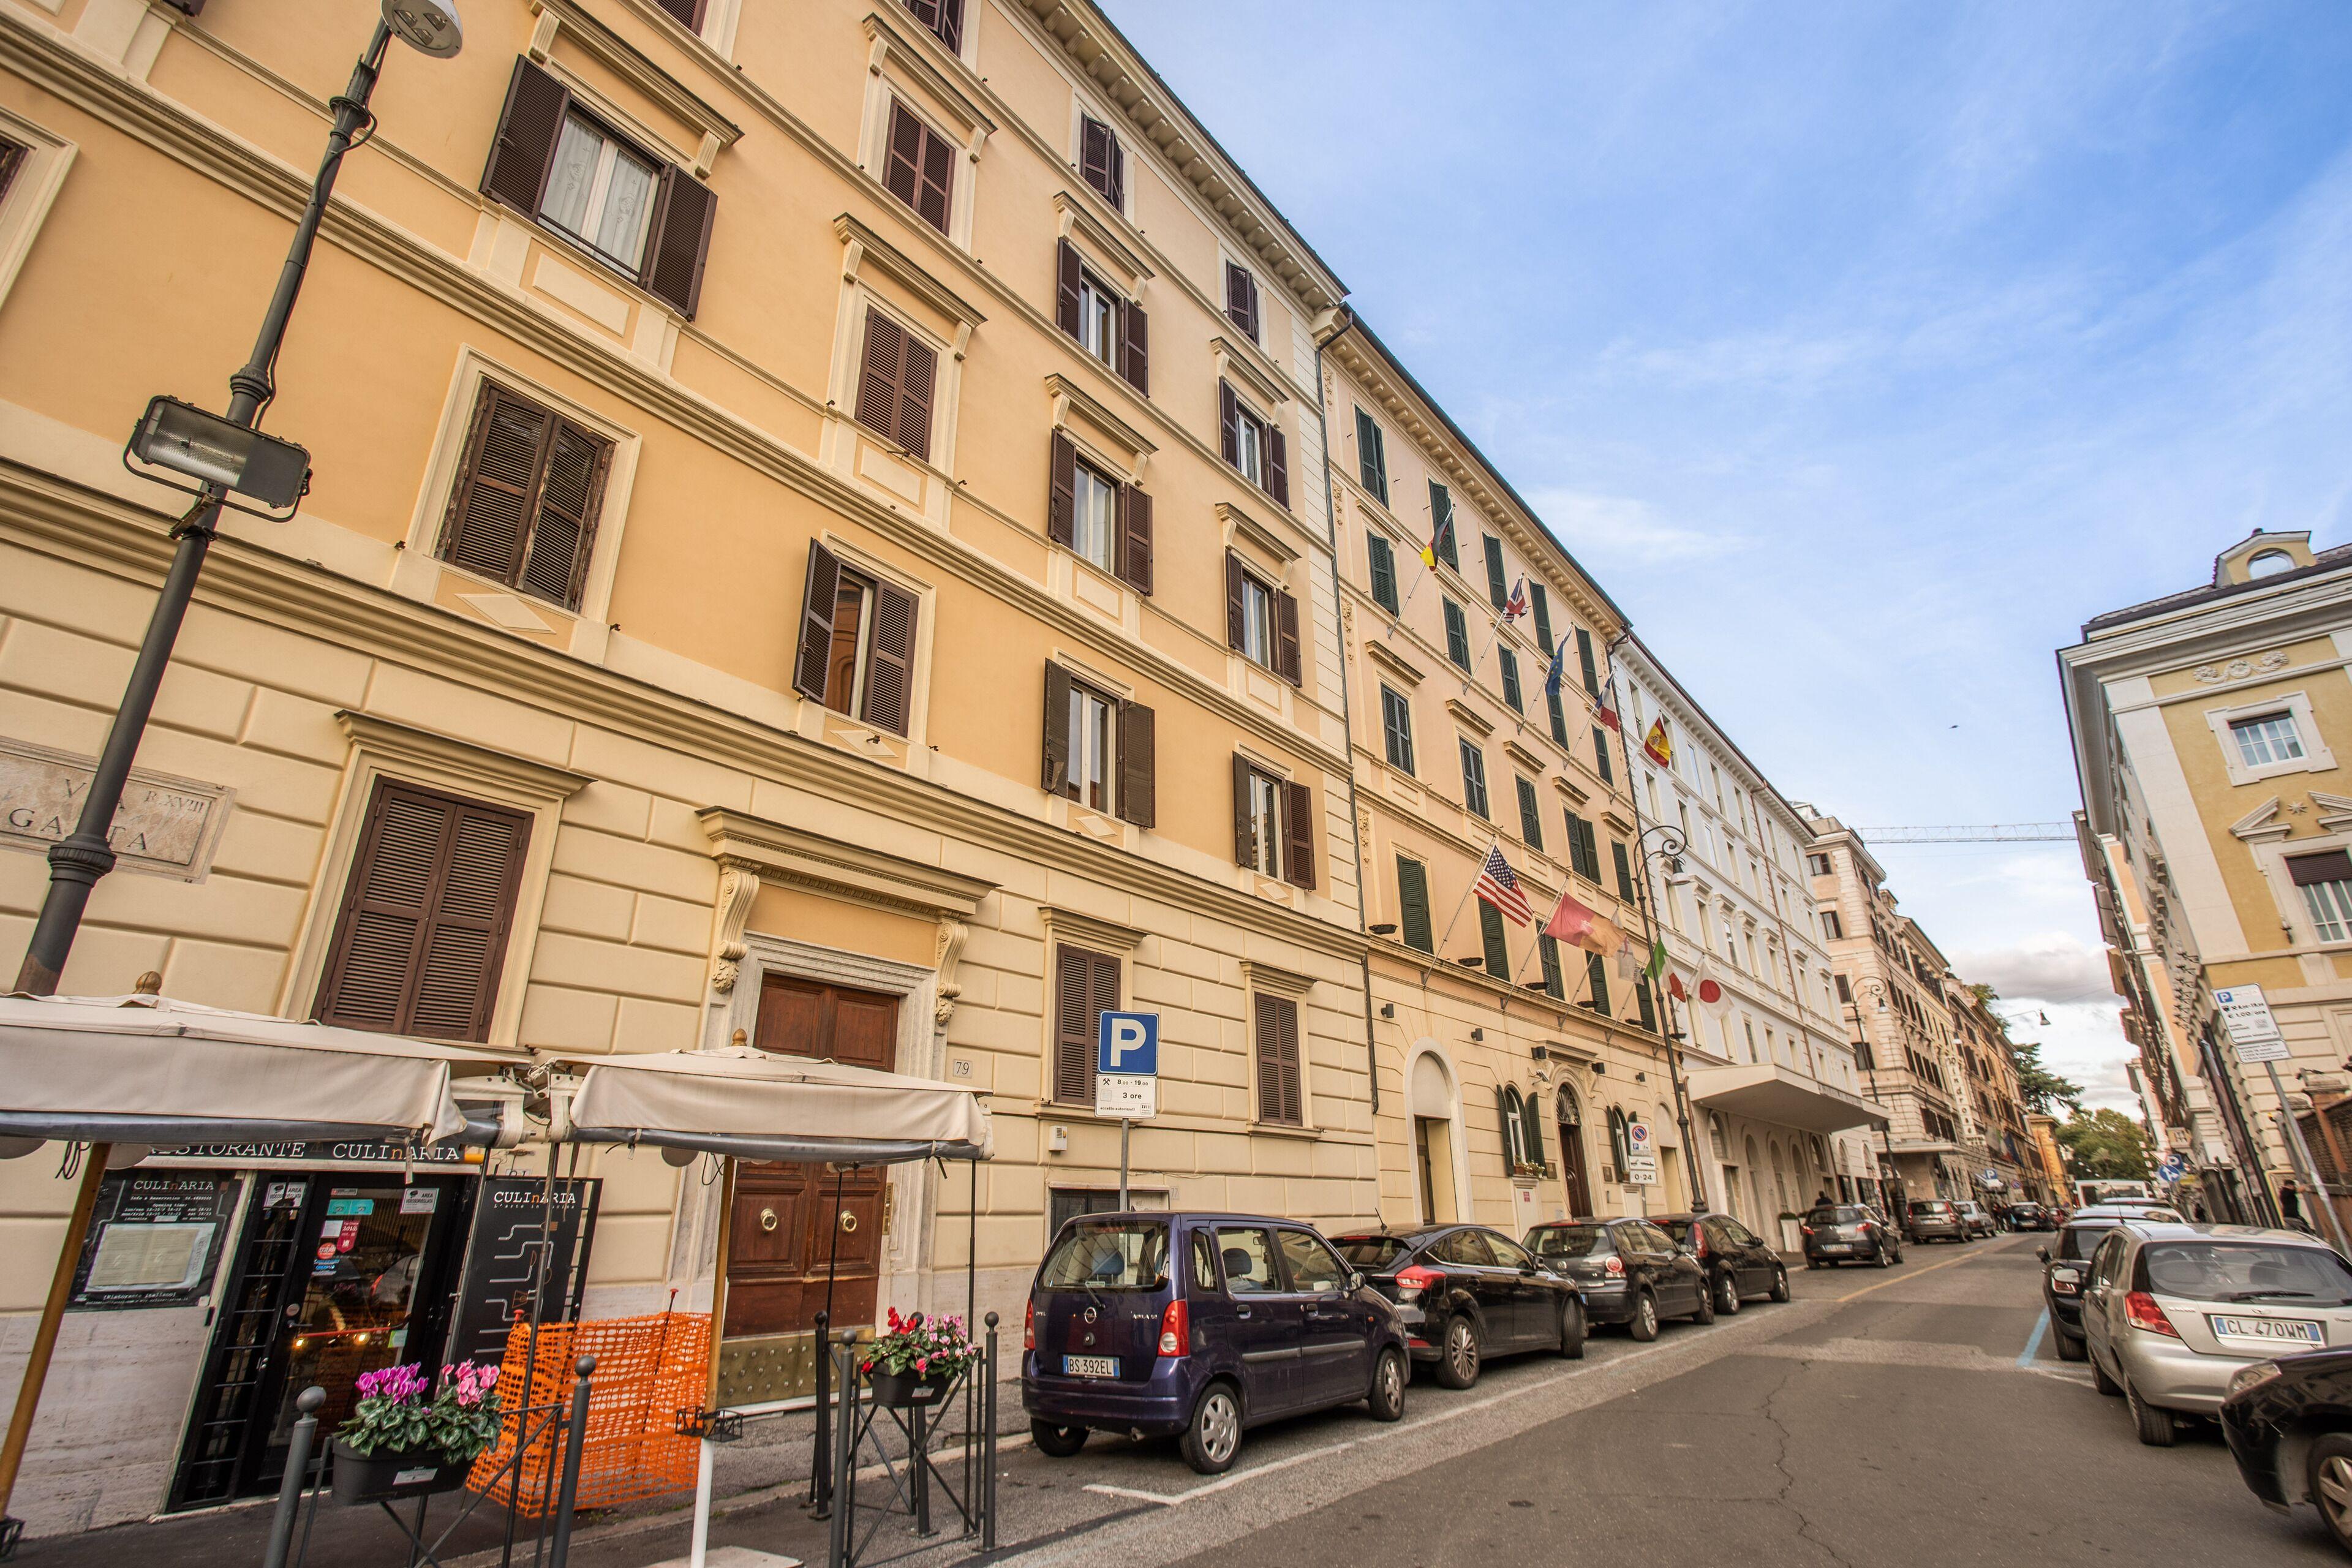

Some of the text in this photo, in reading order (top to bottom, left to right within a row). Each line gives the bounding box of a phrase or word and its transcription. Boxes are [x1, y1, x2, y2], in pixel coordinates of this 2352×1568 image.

[9, 808, 146, 850] GATA
[1110, 1018, 1147, 1067] P
[956, 1061, 970, 1075] 79
[1986, 1170, 1995, 1178] P
[2227, 1320, 2309, 1340] CL 470WM
[1069, 1358, 1112, 1375] BS 392EL
